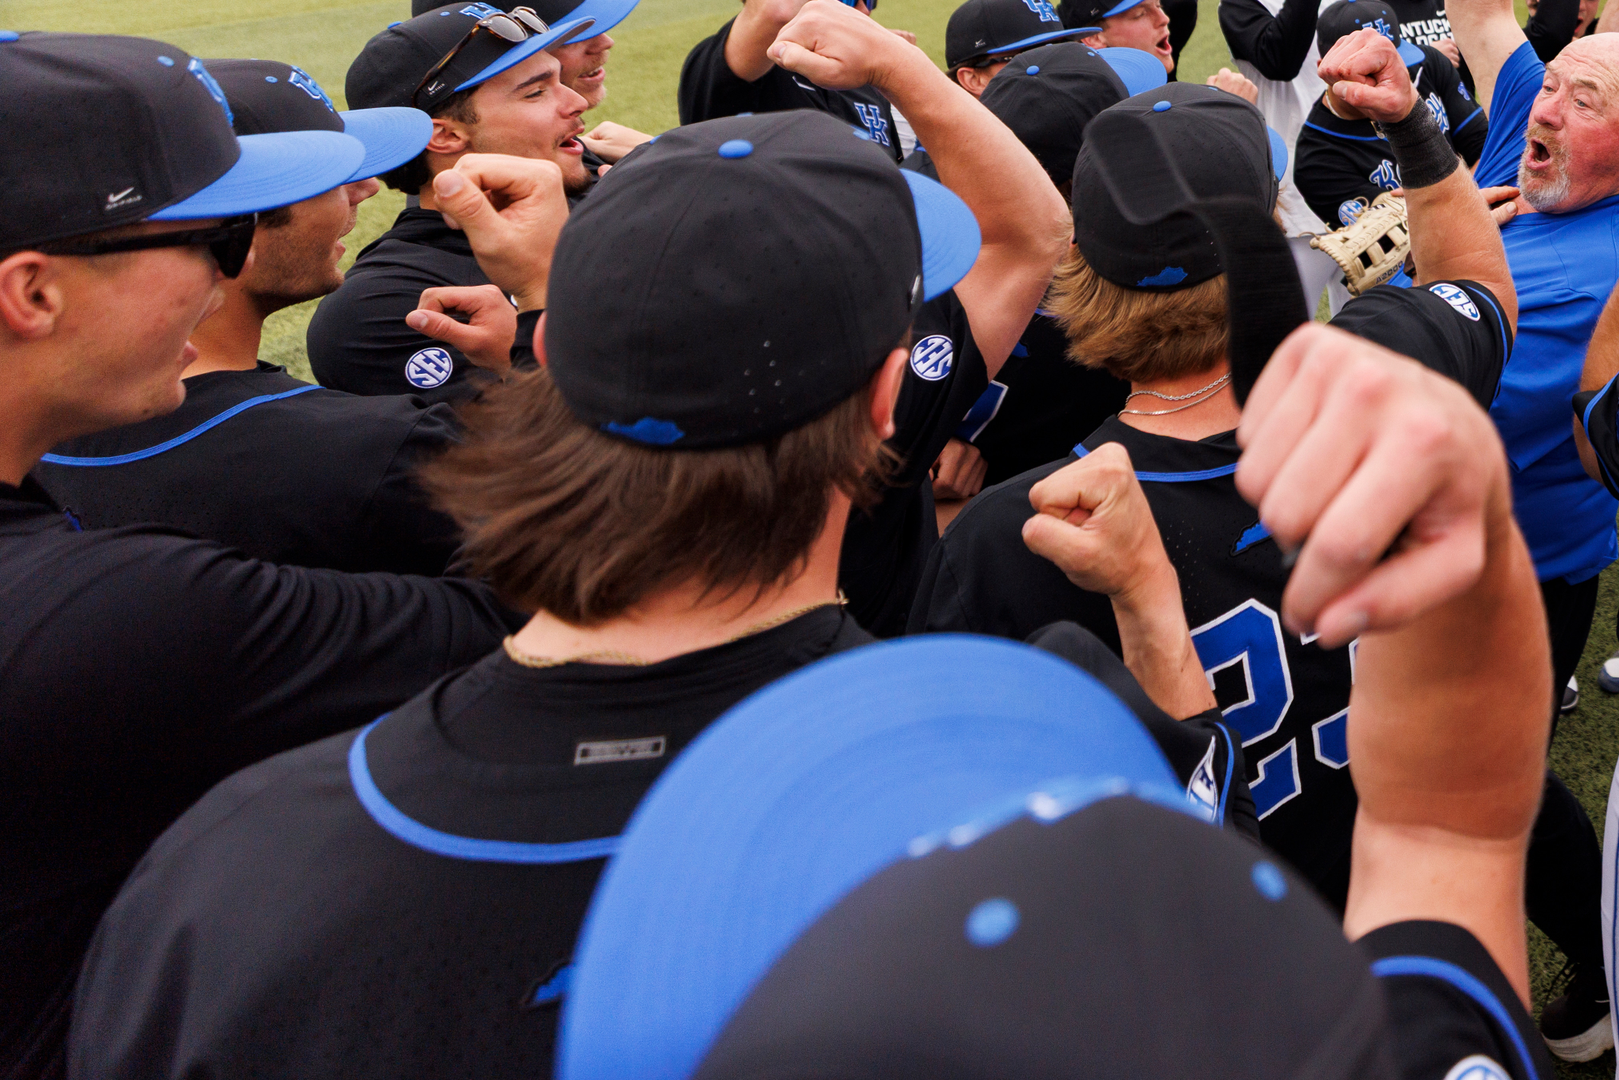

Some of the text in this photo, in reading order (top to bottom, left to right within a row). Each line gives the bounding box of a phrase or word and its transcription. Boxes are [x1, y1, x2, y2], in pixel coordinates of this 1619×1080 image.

[1400, 19, 1452, 38] NTUCK
[854, 102, 890, 146] UK
[1375, 260, 1404, 284] A2000
[405, 347, 453, 388] SEC
[913, 337, 954, 380] SEC
